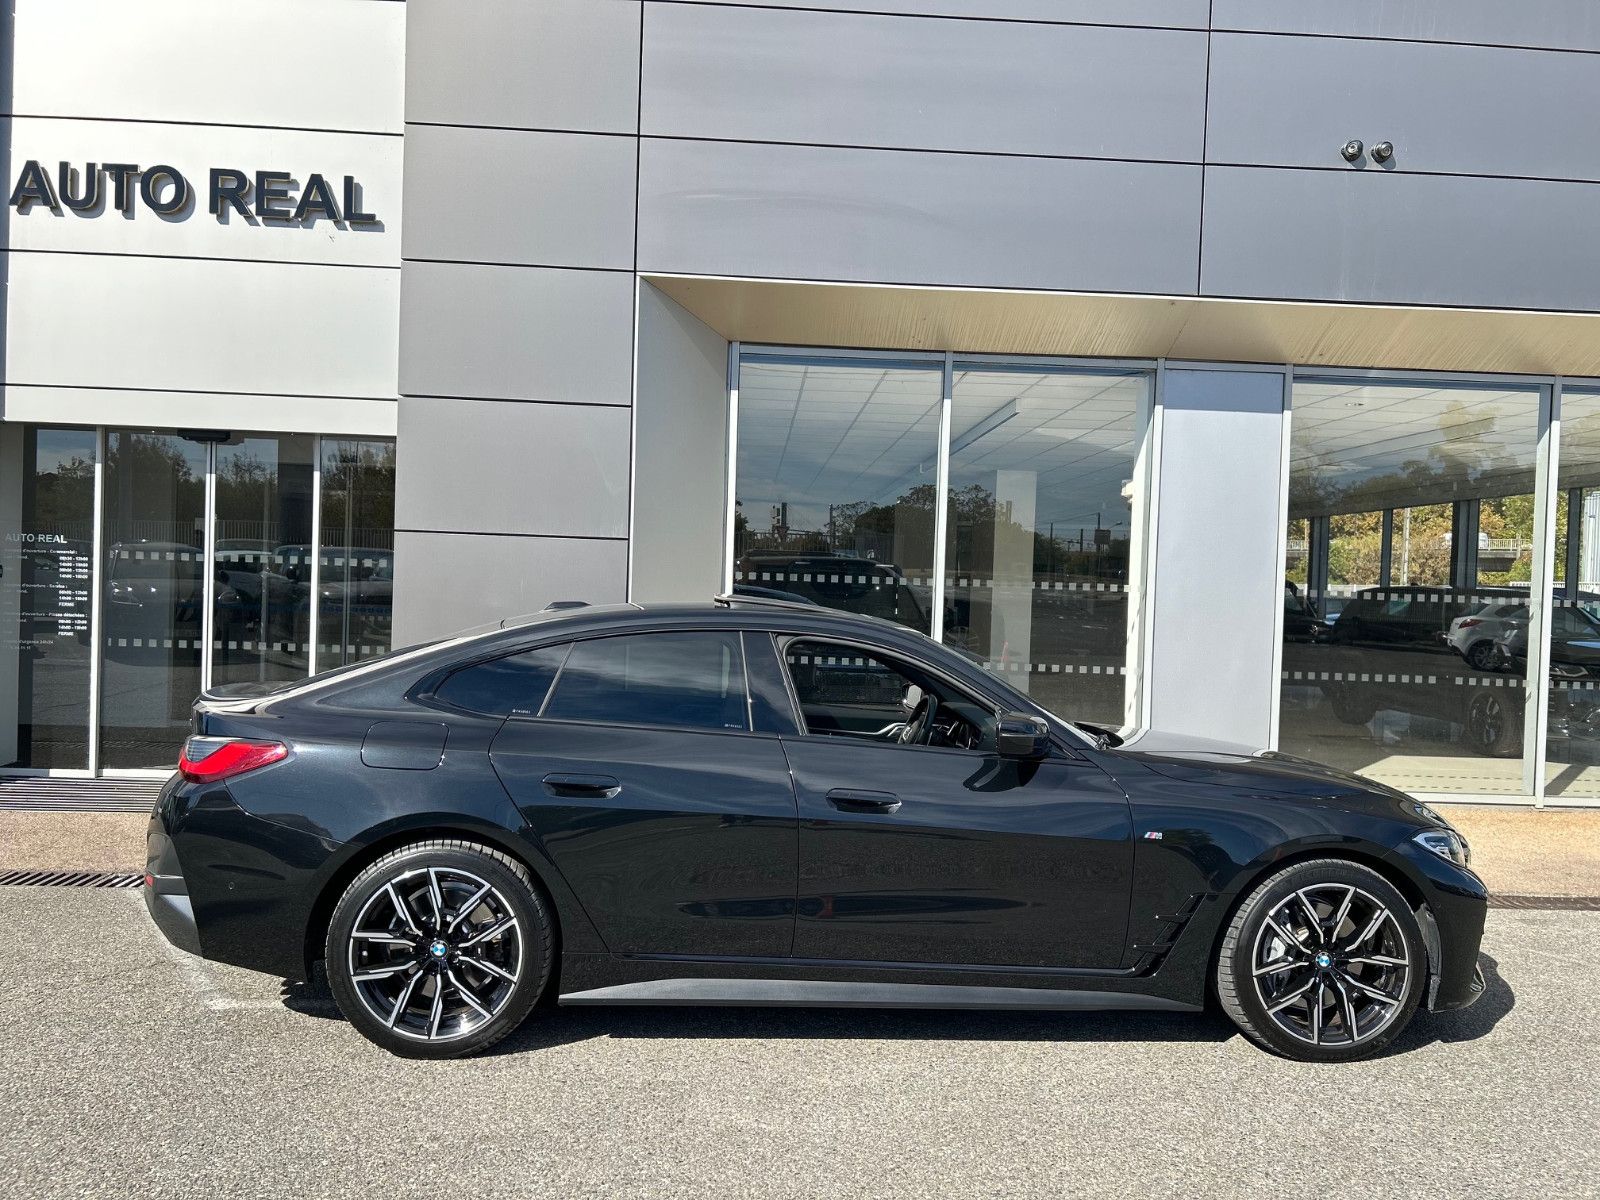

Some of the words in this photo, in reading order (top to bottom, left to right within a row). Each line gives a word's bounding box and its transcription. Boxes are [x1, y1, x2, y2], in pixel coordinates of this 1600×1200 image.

[9, 159, 191, 215] AUTO
[208, 167, 377, 223] REAL
[5, 533, 35, 542] AUTO
[38, 534, 68, 544] REAL
